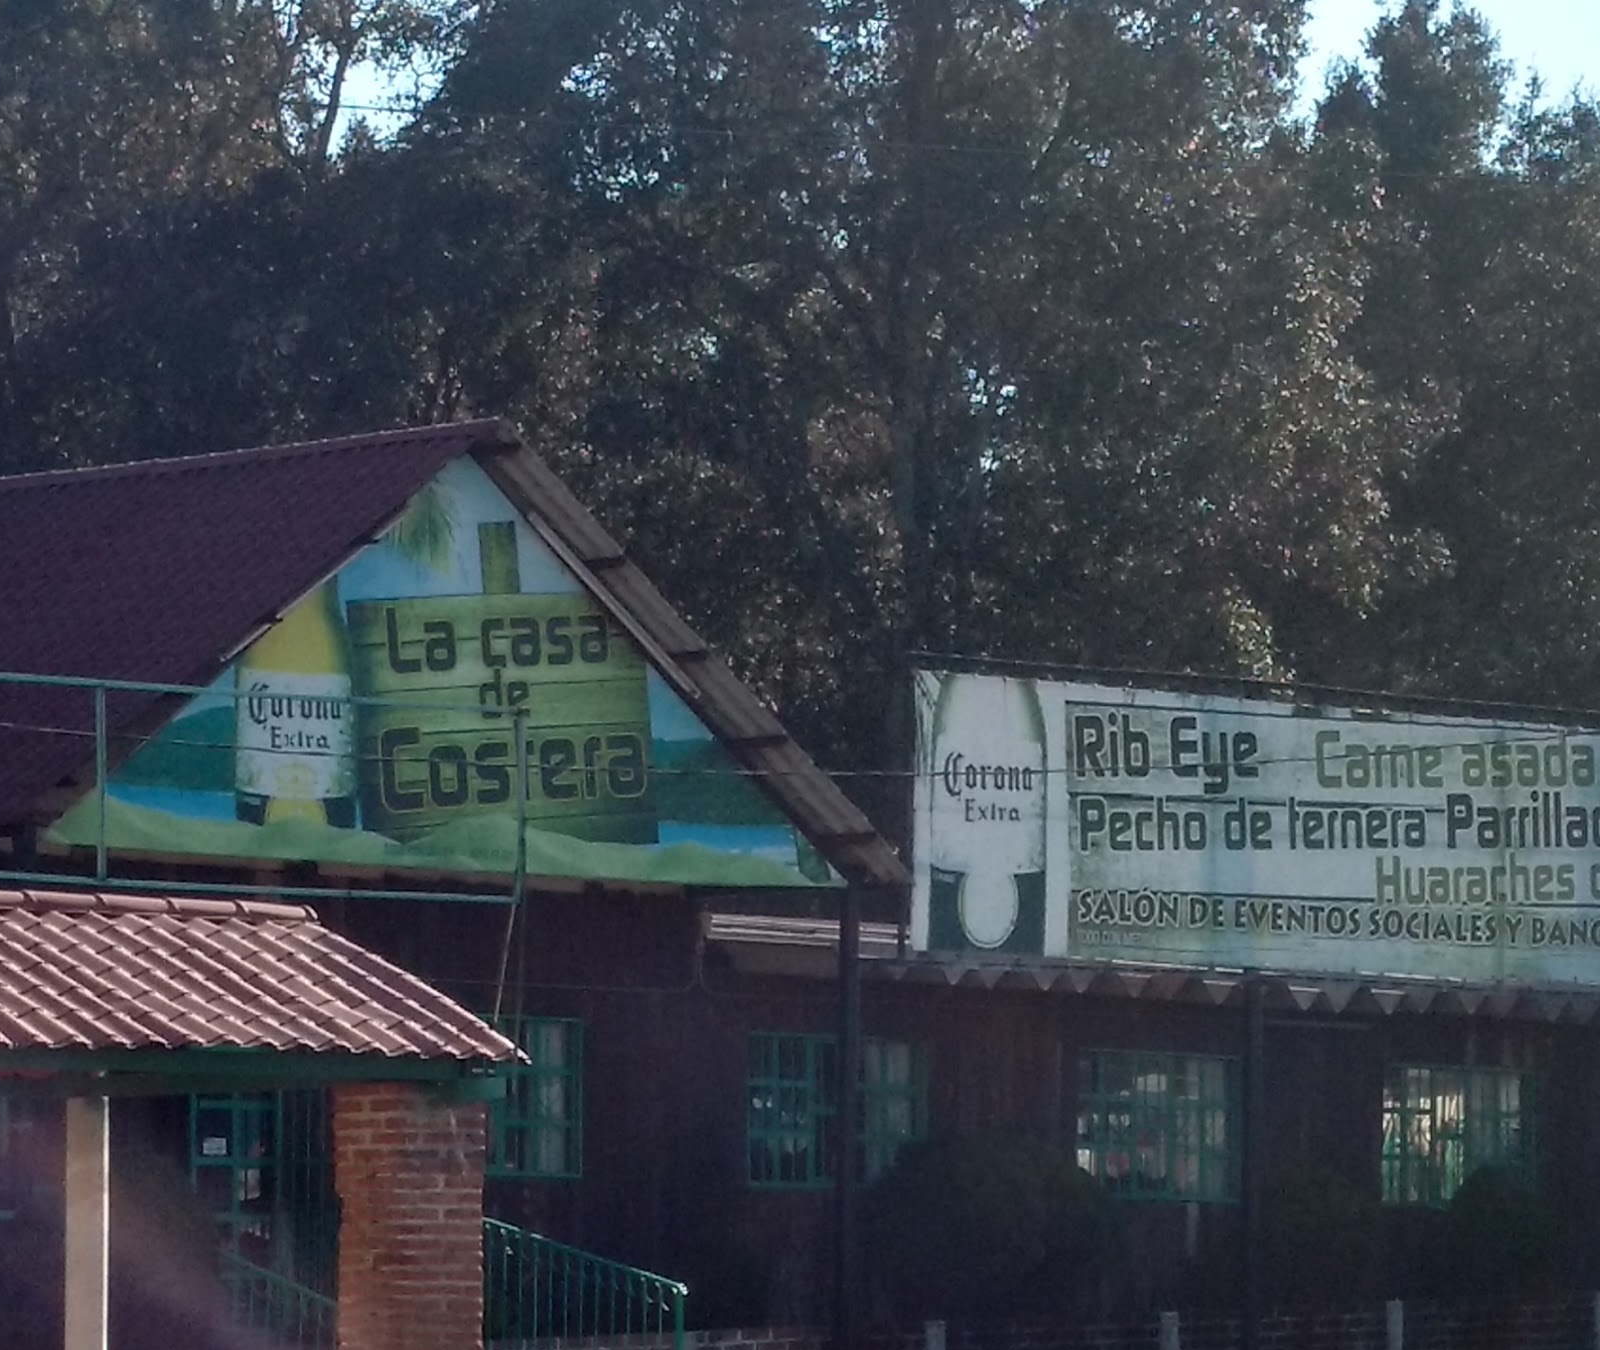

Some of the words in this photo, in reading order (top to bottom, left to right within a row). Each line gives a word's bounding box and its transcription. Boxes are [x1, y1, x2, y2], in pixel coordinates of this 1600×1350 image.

[386, 606, 457, 674] La
[479, 615, 609, 669] casa
[248, 682, 342, 725] Corona
[478, 667, 530, 718] de
[270, 726, 331, 749] Extra
[1074, 710, 1151, 779] Rib
[1169, 715, 1260, 795] Eye
[1315, 730, 1444, 789] Carne
[1461, 729, 1596, 788] asada
[943, 751, 1033, 797] Corona
[965, 798, 1021, 823] Extra
[1078, 797, 1207, 852] Pecho
[1224, 797, 1272, 850] de
[1288, 797, 1427, 850] ternera
[1375, 853, 1576, 904] Huaraches
[1078, 887, 1180, 928] SALÓN
[1188, 897, 1225, 929] DE
[1234, 898, 1362, 936] EVENTOS
[1368, 908, 1496, 945] SOCIALES
[1505, 915, 1524, 945] Y
